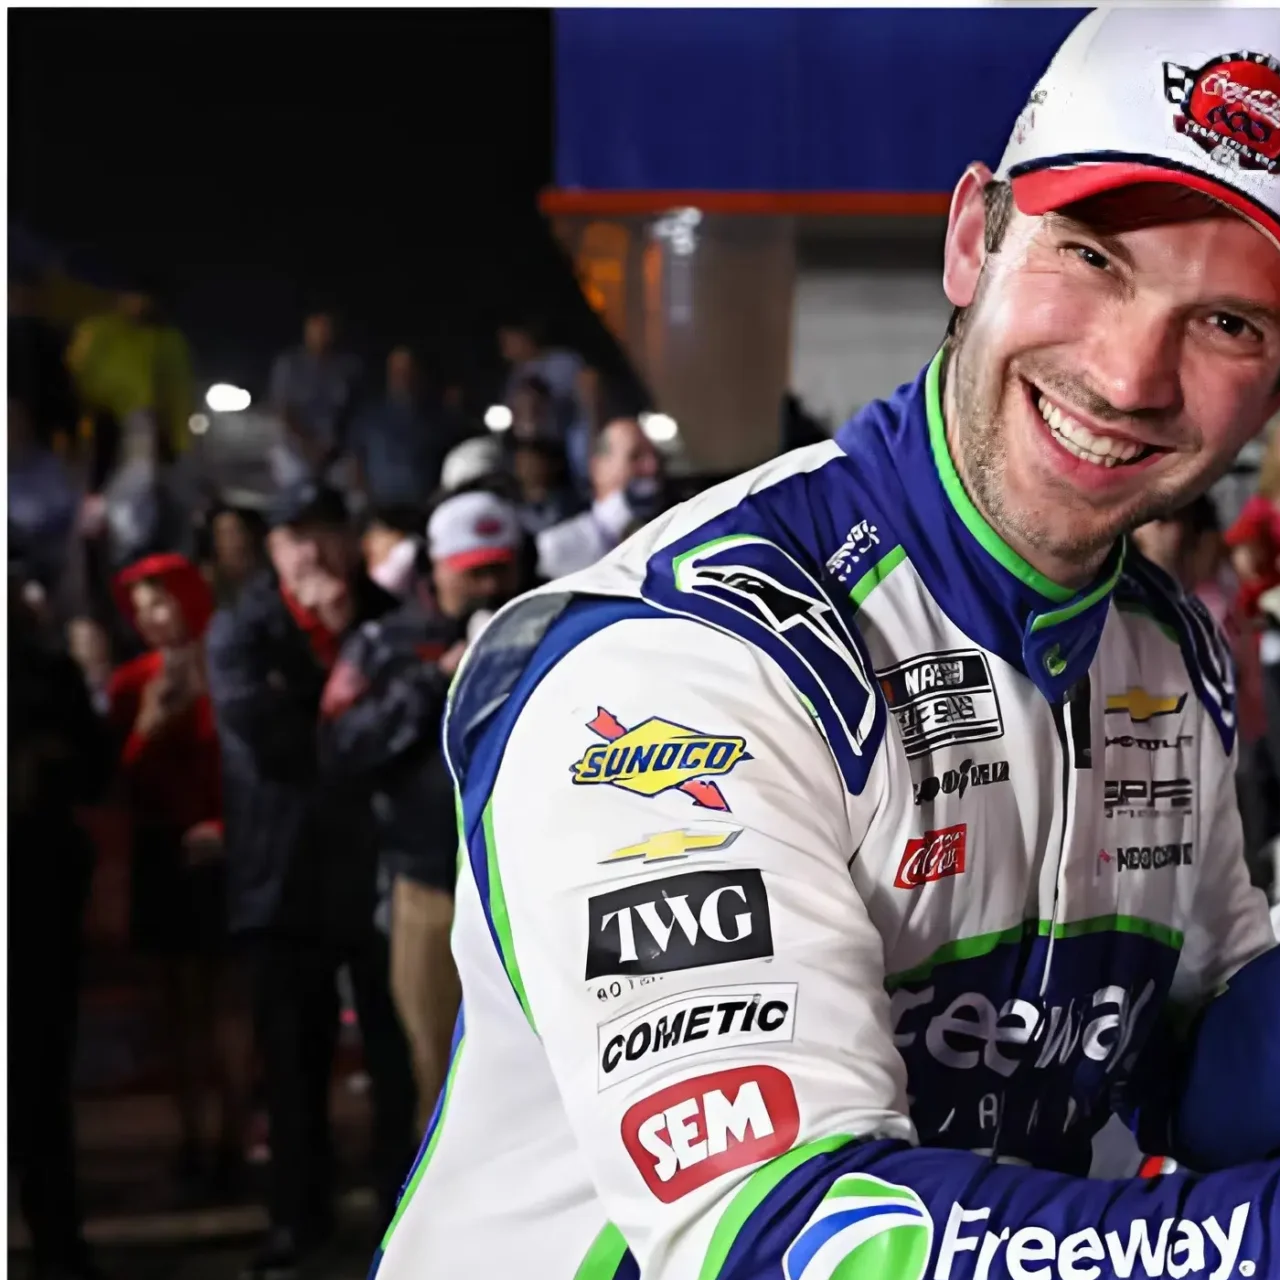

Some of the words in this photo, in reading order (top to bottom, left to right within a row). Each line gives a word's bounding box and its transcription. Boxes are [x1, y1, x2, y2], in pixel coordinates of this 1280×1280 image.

[584, 740, 740, 778] SUNOCO
[600, 885, 753, 963] TWG
[601, 997, 790, 1074] COMETIC
[637, 1080, 775, 1182] SEM
